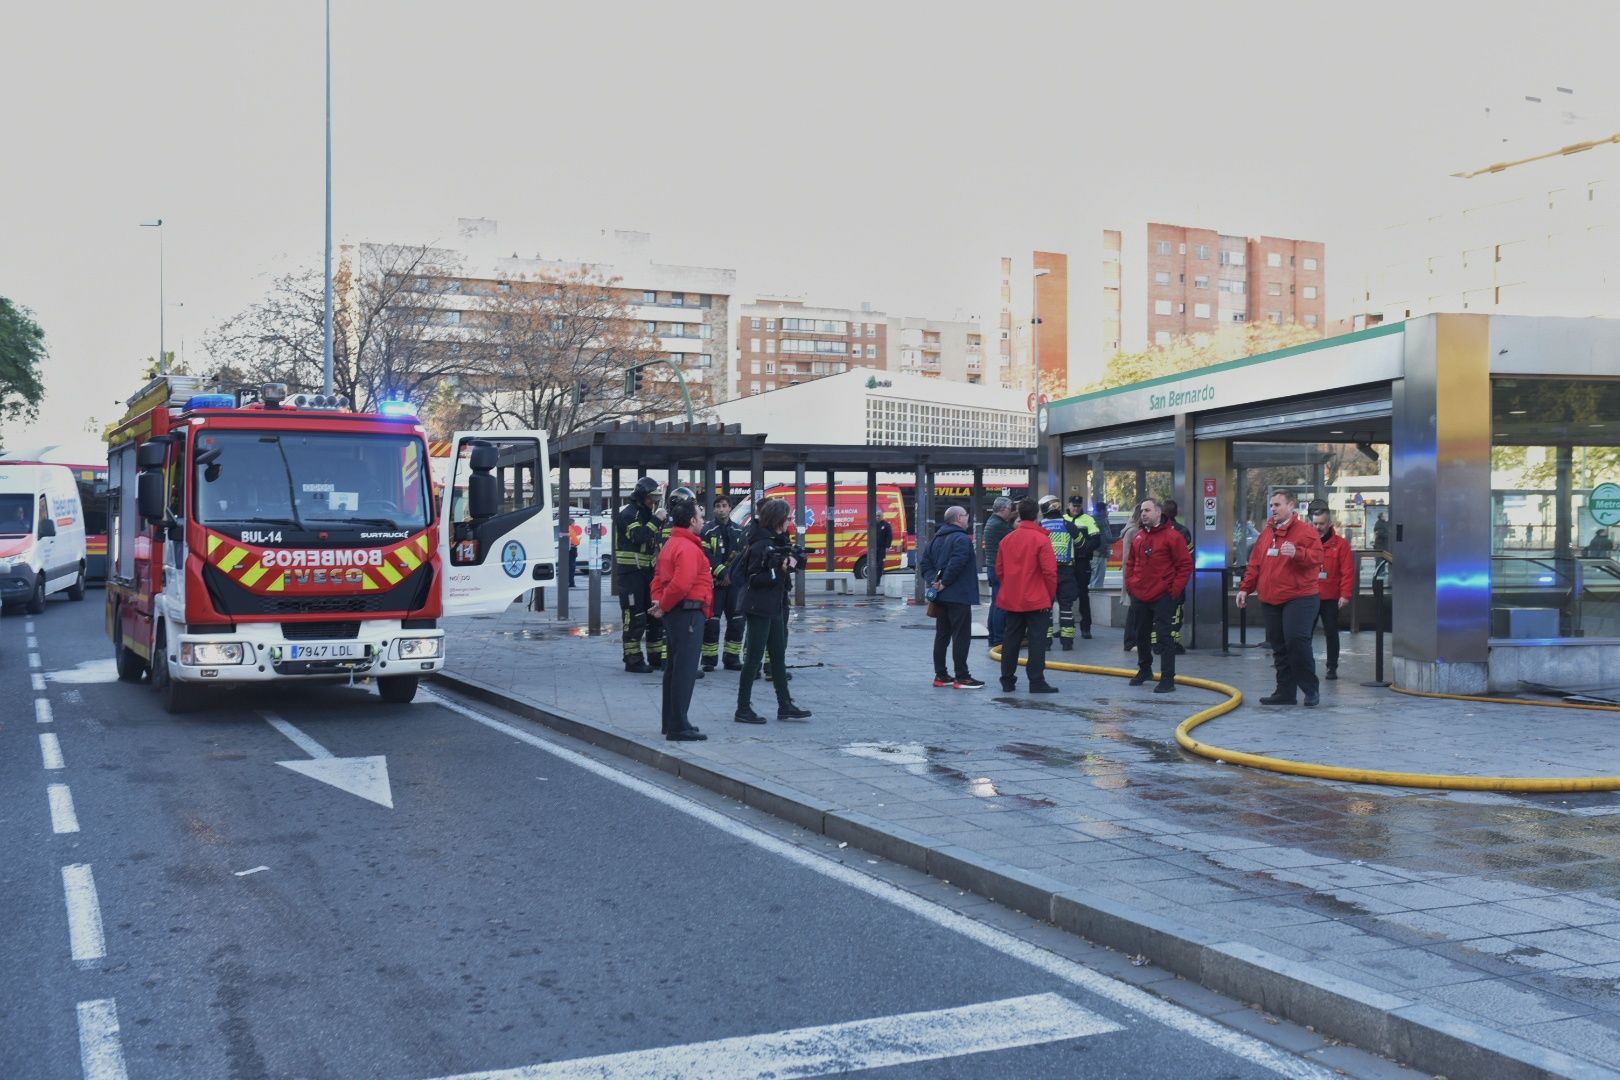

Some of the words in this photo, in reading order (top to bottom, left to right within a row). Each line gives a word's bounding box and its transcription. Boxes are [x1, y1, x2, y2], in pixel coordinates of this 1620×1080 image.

[1150, 394, 1166, 410] San
[1169, 384, 1215, 407] Bernardo
[934, 487, 971, 497] EVILLA
[241, 531, 282, 543] BUL-14
[456, 543, 475, 561] 14
[284, 568, 363, 585] IVECO
[298, 646, 328, 657] 7947
[331, 645, 353, 656] LDL
